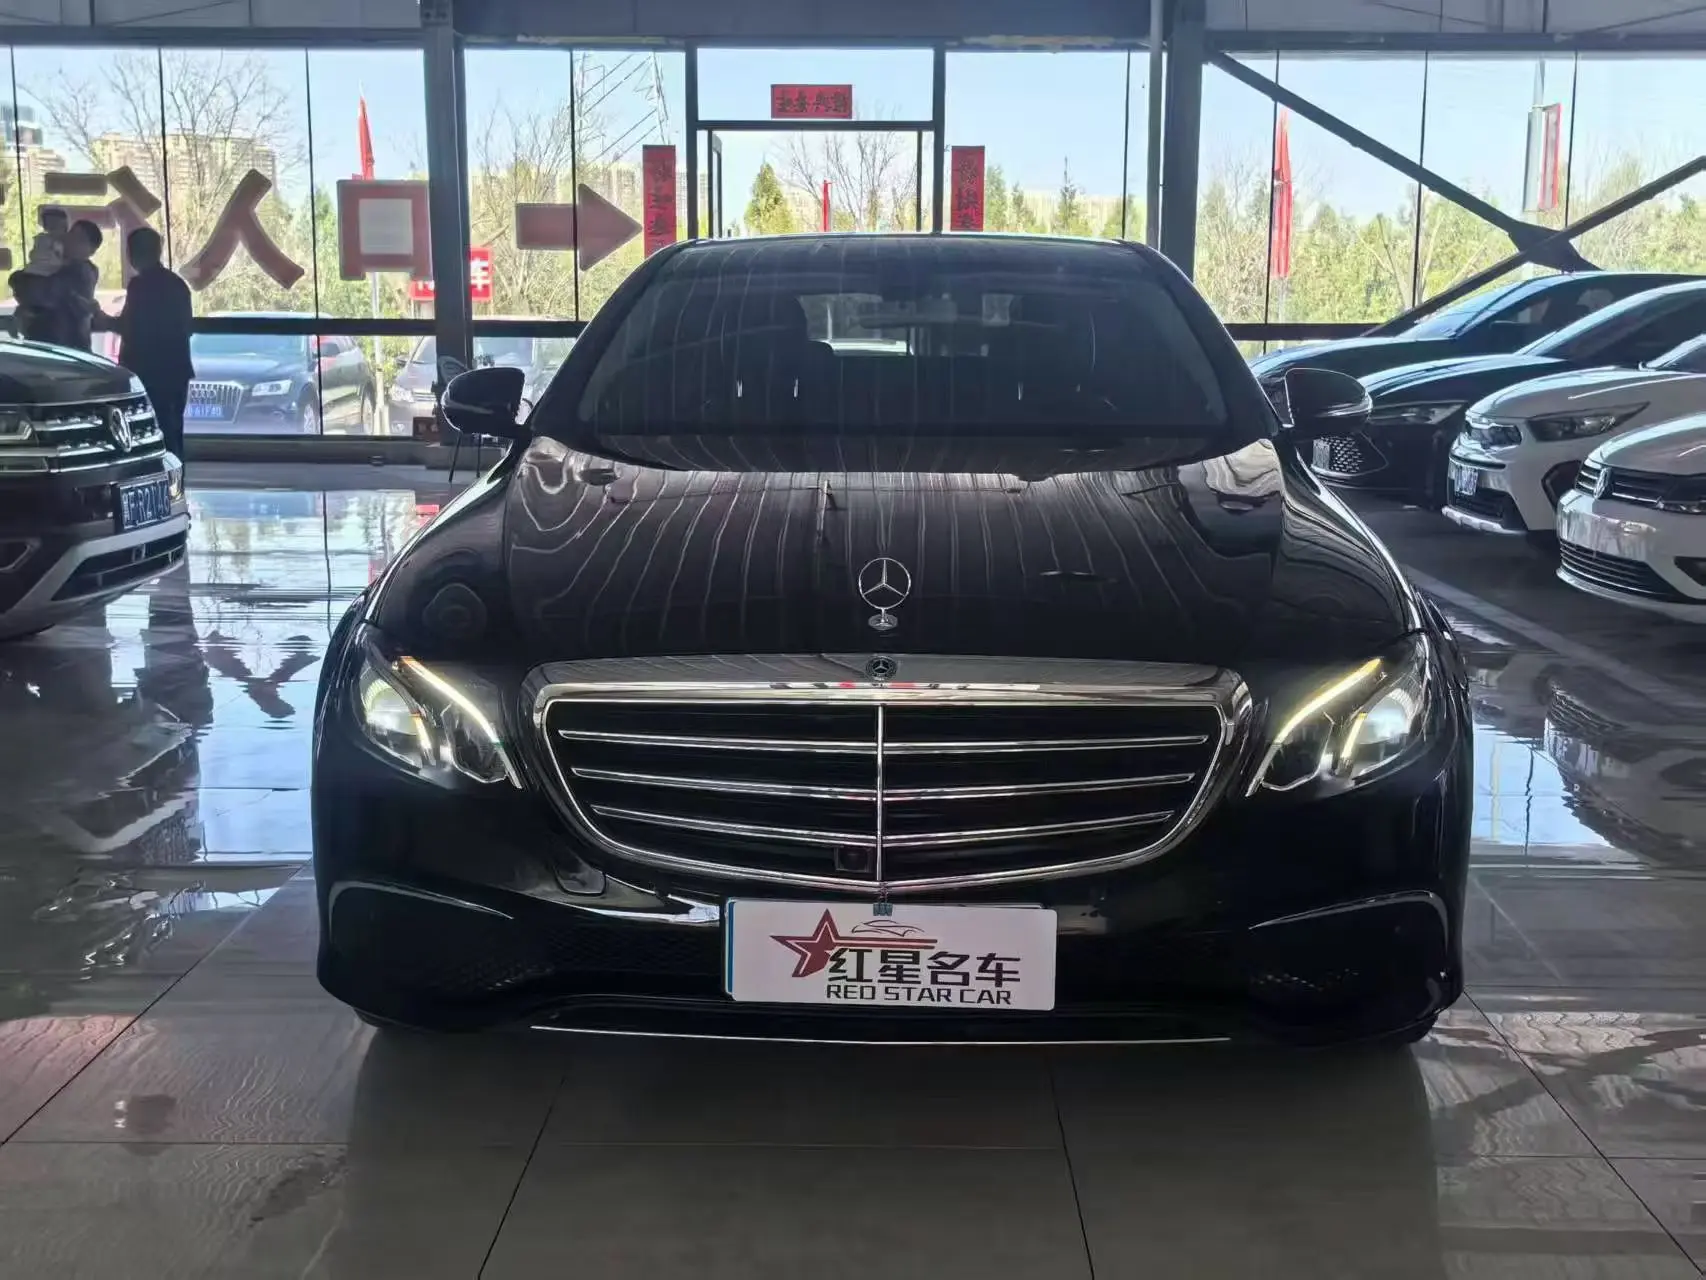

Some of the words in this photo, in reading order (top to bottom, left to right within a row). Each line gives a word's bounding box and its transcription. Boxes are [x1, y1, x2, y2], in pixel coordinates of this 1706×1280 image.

[828, 947, 1021, 988] 红星名车
[826, 984, 876, 1000] RED
[884, 986, 952, 1003] STAR
[959, 988, 1012, 1005] CAR
